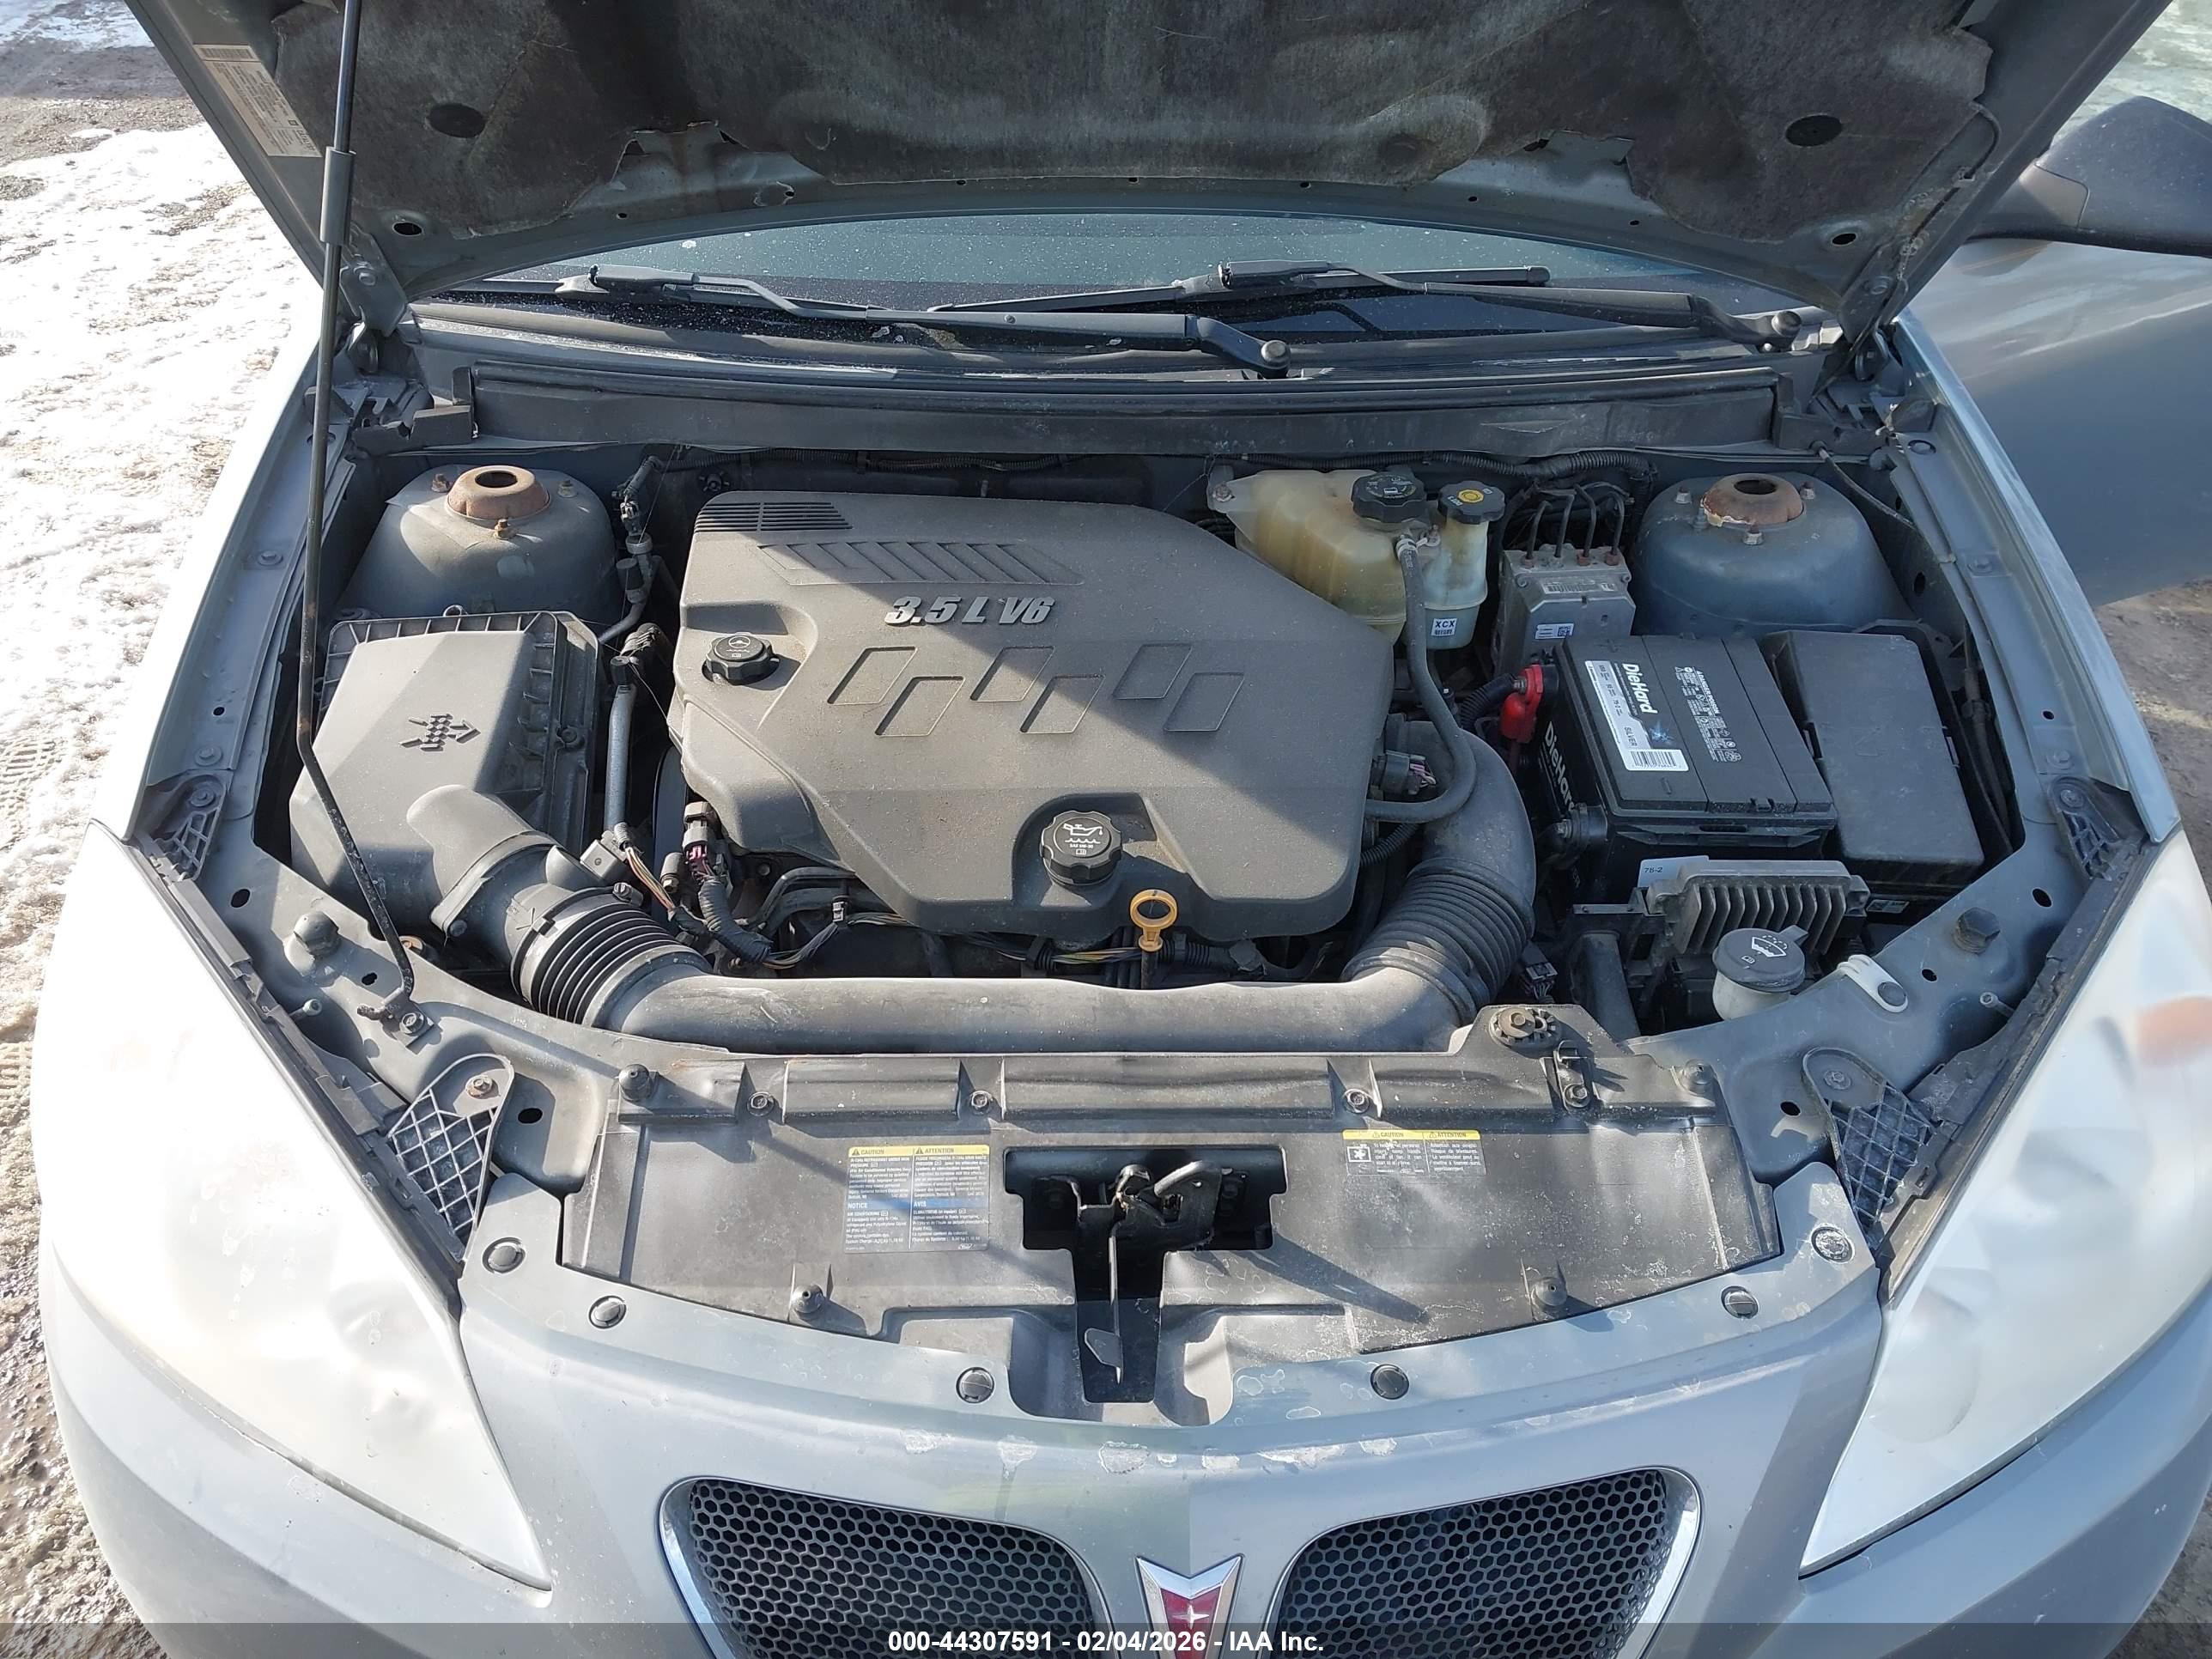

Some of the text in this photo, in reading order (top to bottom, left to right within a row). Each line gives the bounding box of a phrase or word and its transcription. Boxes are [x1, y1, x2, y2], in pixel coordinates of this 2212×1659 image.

[884, 596, 1055, 625] 3.5 L V6
[1435, 620, 1455, 629] XCX
[1622, 663, 1657, 714] DieHard
[1624, 726, 1638, 747] SILVER
